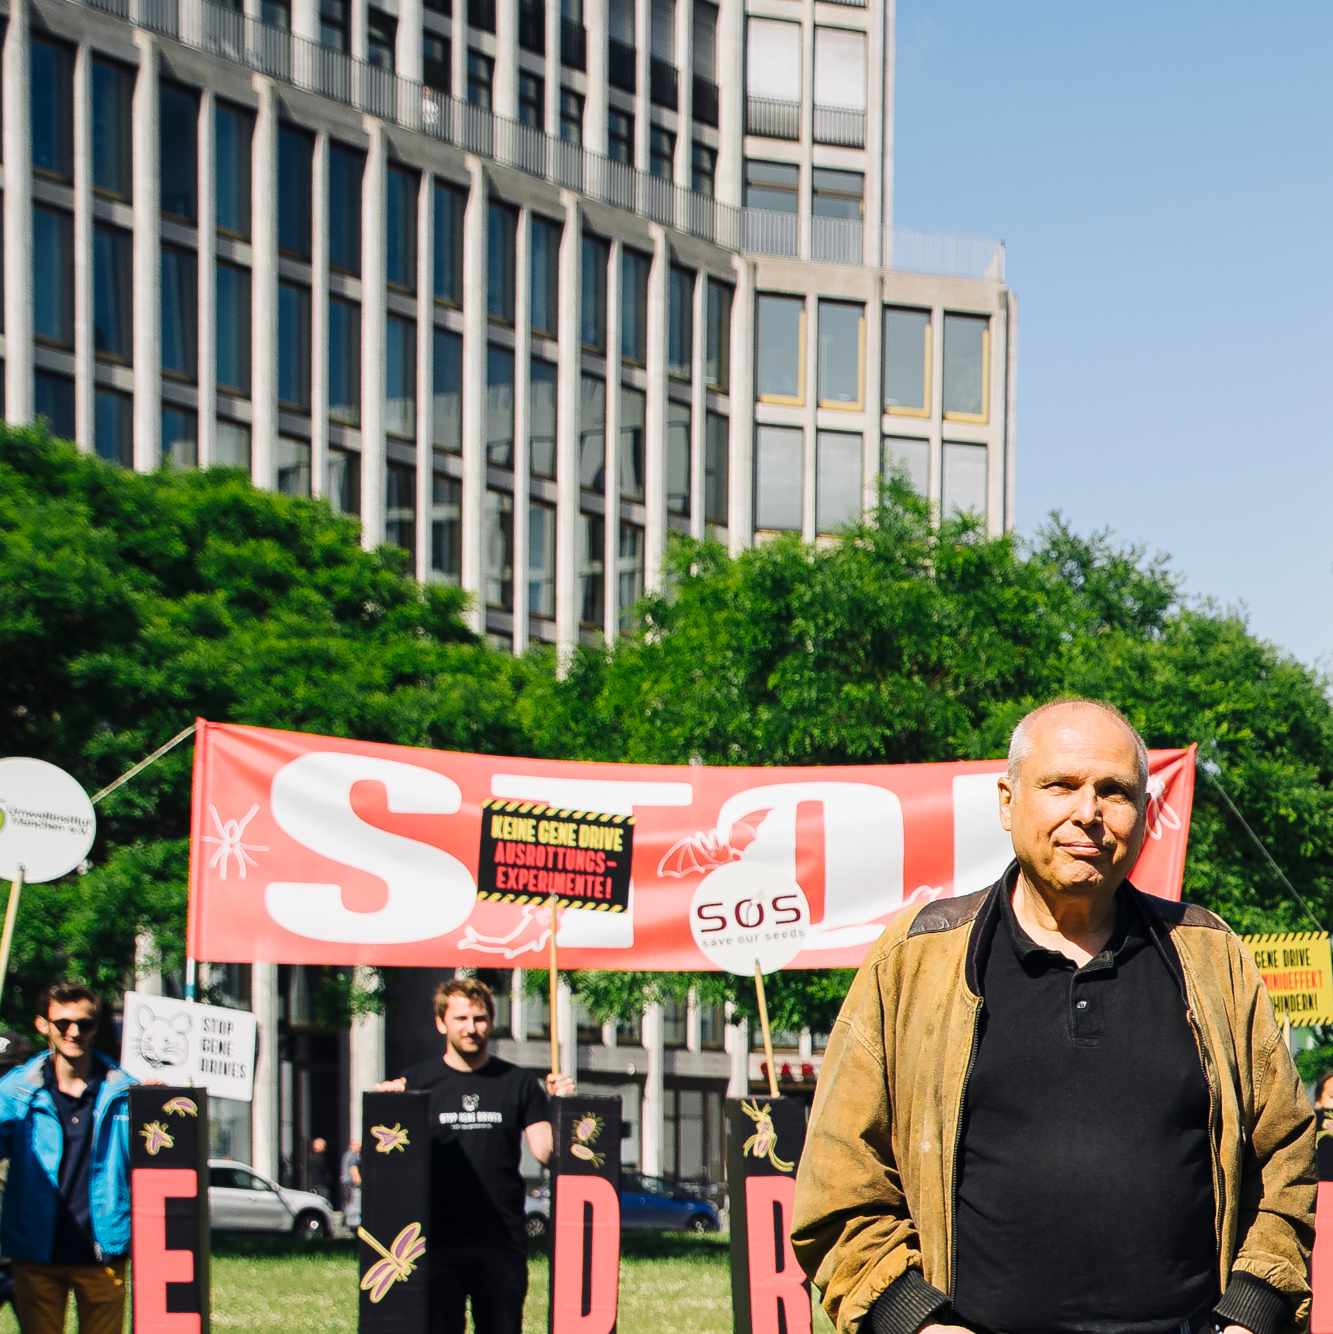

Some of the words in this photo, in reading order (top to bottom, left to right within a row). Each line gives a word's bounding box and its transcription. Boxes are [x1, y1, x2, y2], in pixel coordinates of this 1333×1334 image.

[491, 814, 537, 842] KEINE
[538, 819, 577, 847] GENE
[578, 823, 624, 852] DRIVE
[265, 751, 1016, 950] STO
[494, 840, 617, 874] AUSROTTUNGS-
[495, 866, 613, 899] EXPERIMENTE!
[697, 894, 801, 933] SOS
[703, 936, 733, 948] save
[738, 933, 760, 945] our
[765, 928, 806, 941] seeds
[1255, 949, 1279, 969] GENE
[1283, 948, 1311, 968] DRIVE
[203, 1018, 234, 1036] STOP
[202, 1038, 233, 1057] GENE
[201, 1058, 247, 1079] DRIVES
